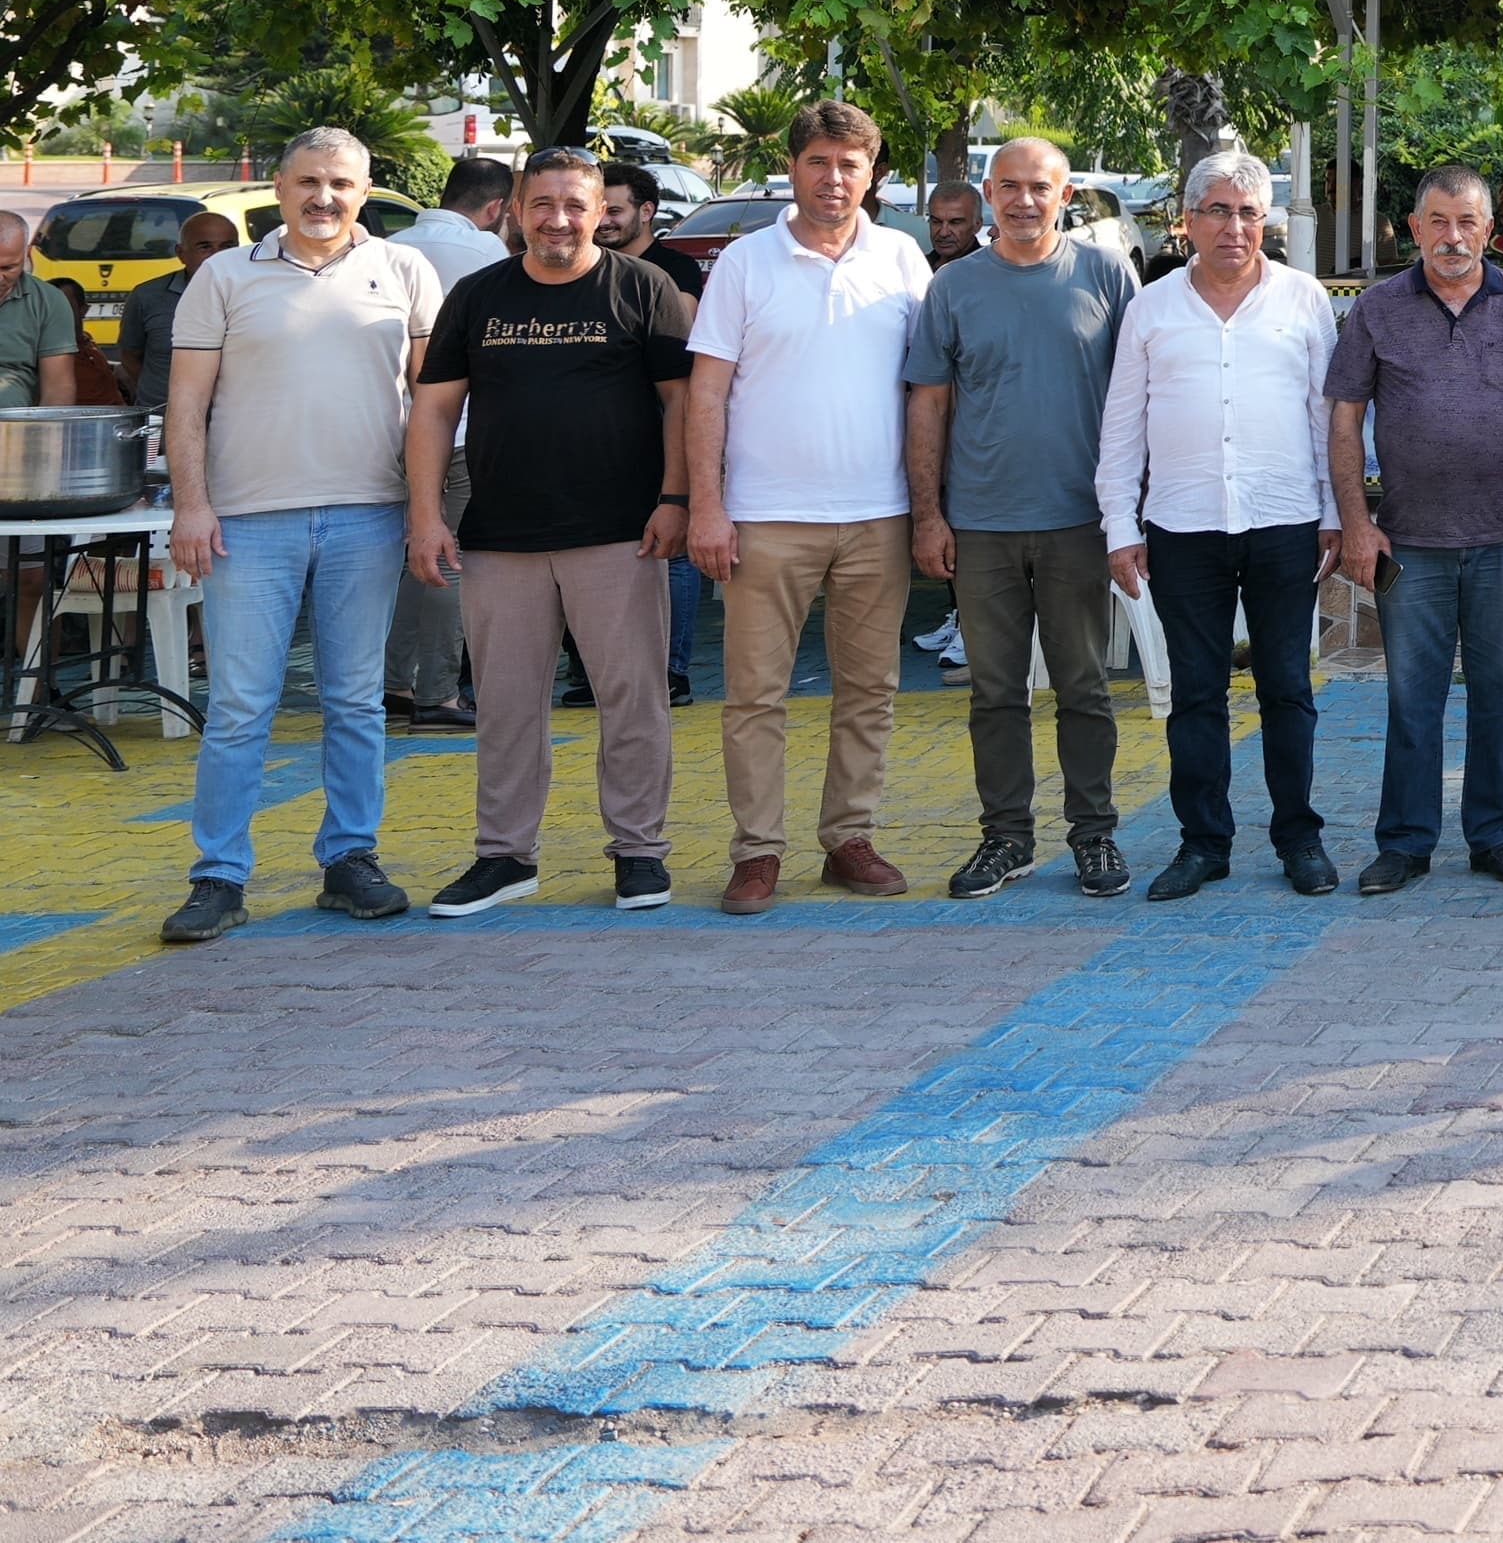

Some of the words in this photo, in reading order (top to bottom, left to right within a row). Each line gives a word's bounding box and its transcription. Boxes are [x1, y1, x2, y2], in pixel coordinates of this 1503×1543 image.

[482, 337, 516, 347] LONDON
[528, 337, 553, 345] PARIS
[583, 335, 608, 344] YORK
